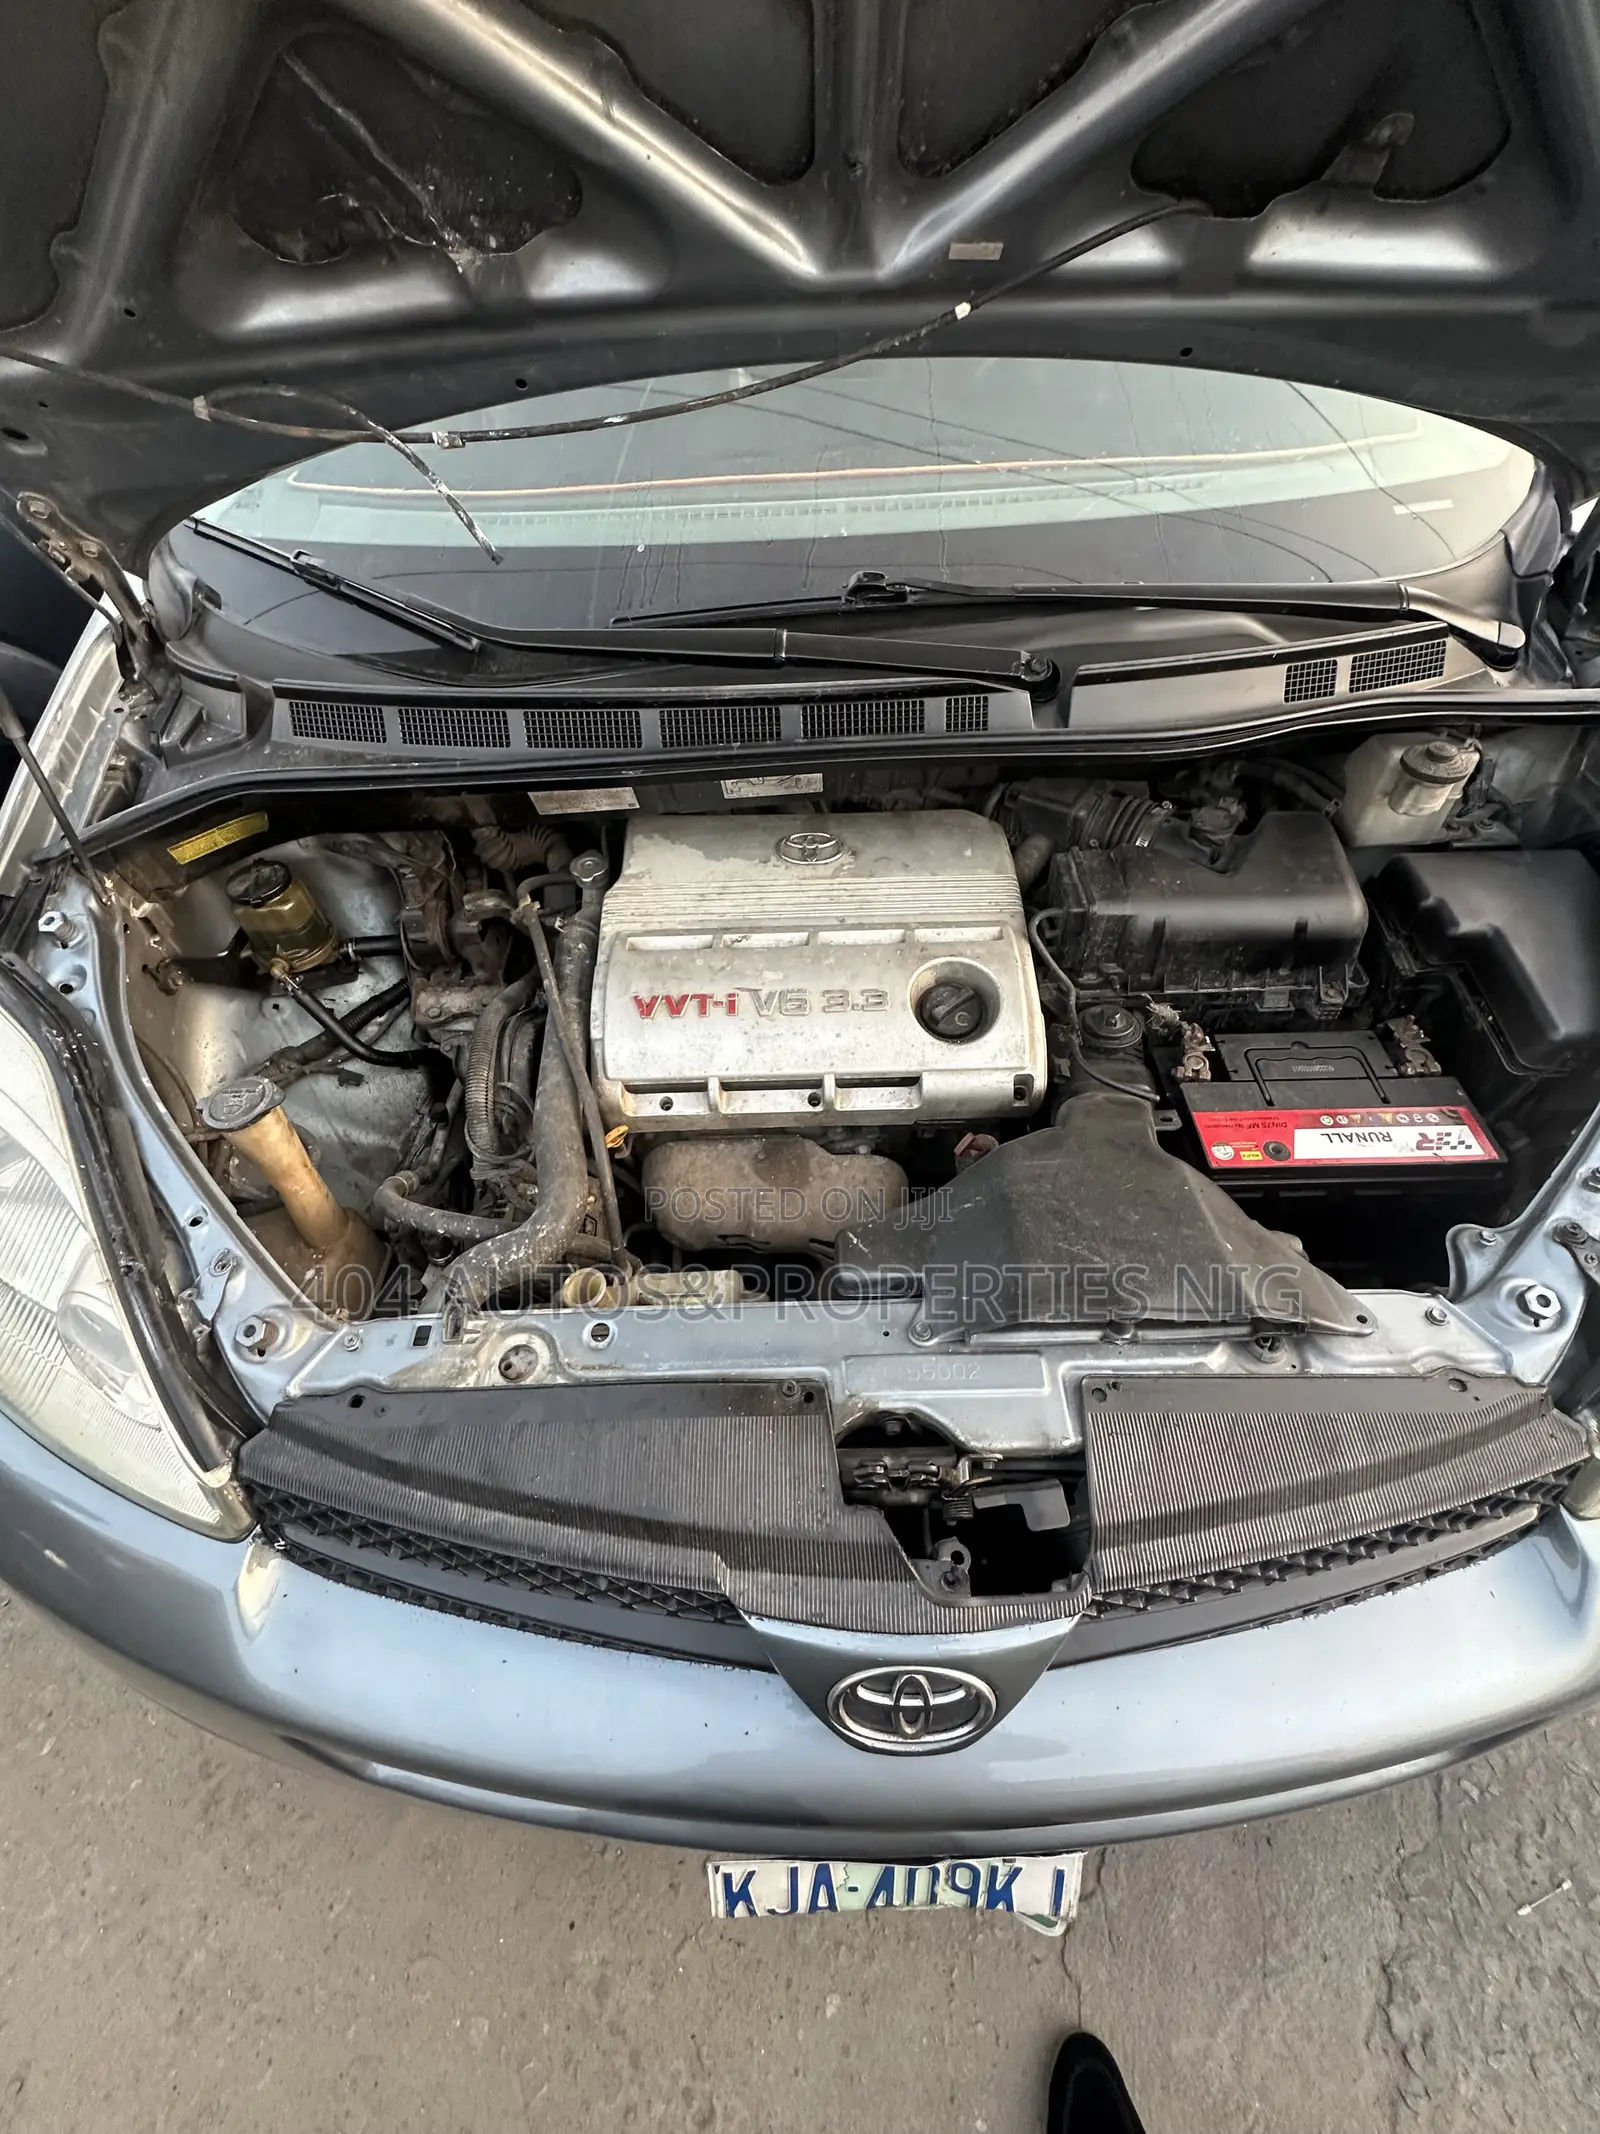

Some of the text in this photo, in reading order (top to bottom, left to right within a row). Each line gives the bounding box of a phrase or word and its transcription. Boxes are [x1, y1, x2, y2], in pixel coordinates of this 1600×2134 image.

[633, 988, 891, 1019] VVT-i V6 3.3
[1320, 1131, 1393, 1144] RUNALL
